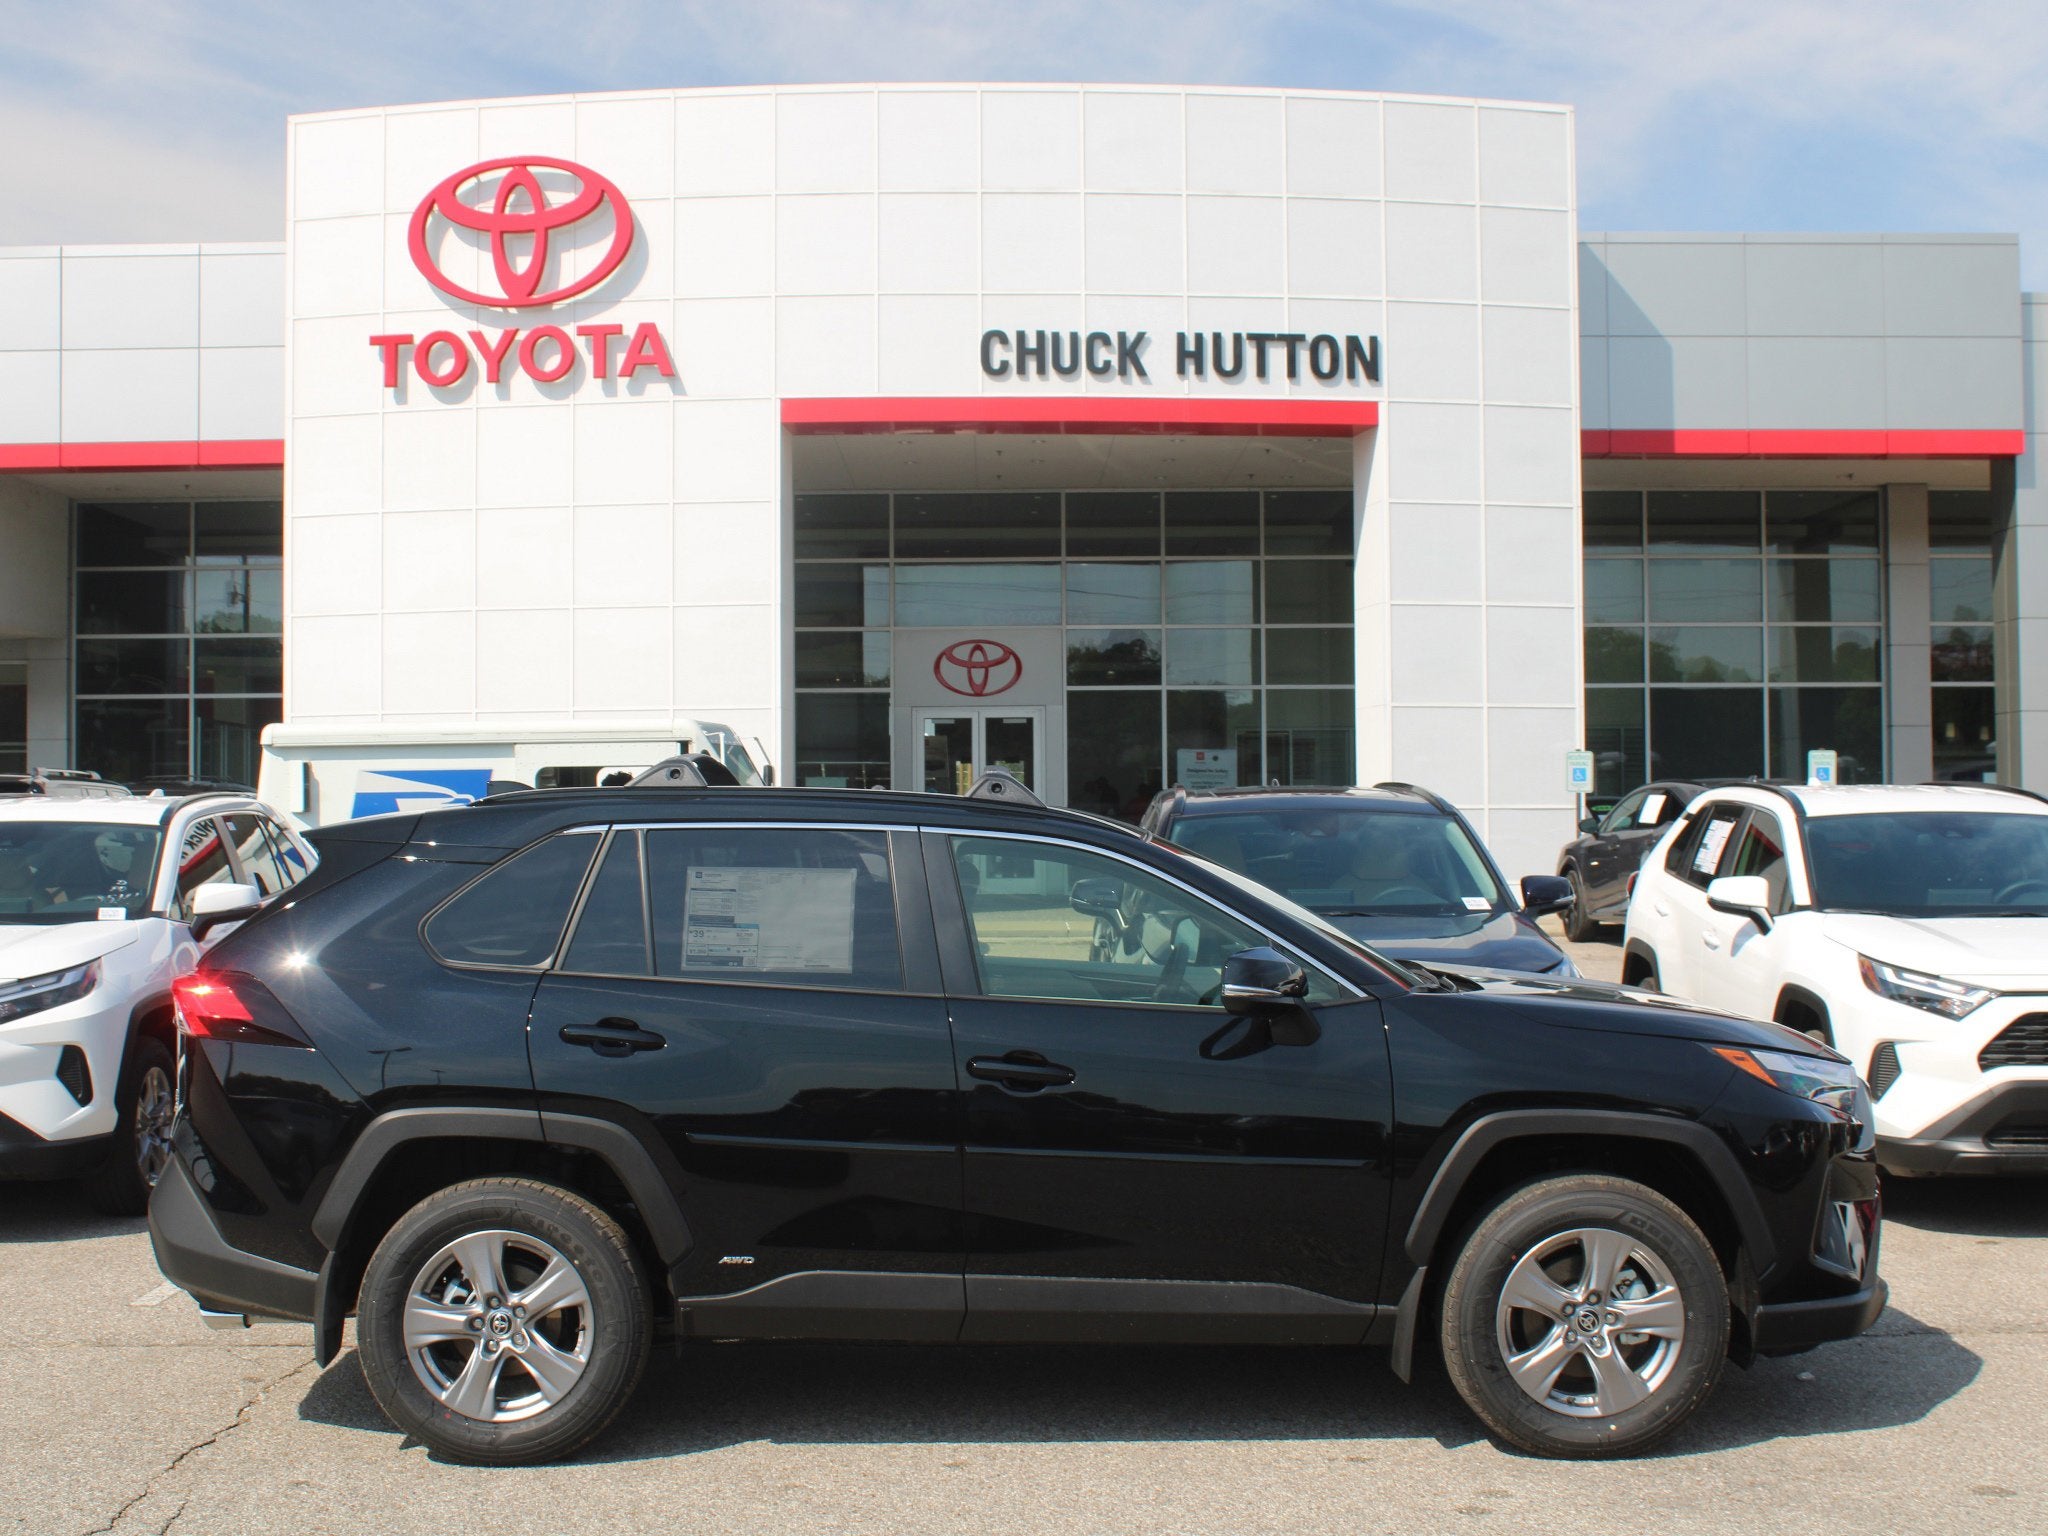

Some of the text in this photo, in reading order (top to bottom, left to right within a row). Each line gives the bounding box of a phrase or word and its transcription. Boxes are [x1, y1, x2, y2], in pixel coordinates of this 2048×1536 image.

[369, 322, 676, 388] TOYOTA
[980, 329, 1380, 382] CHUCK HUTTON
[718, 1256, 755, 1264] AWD
